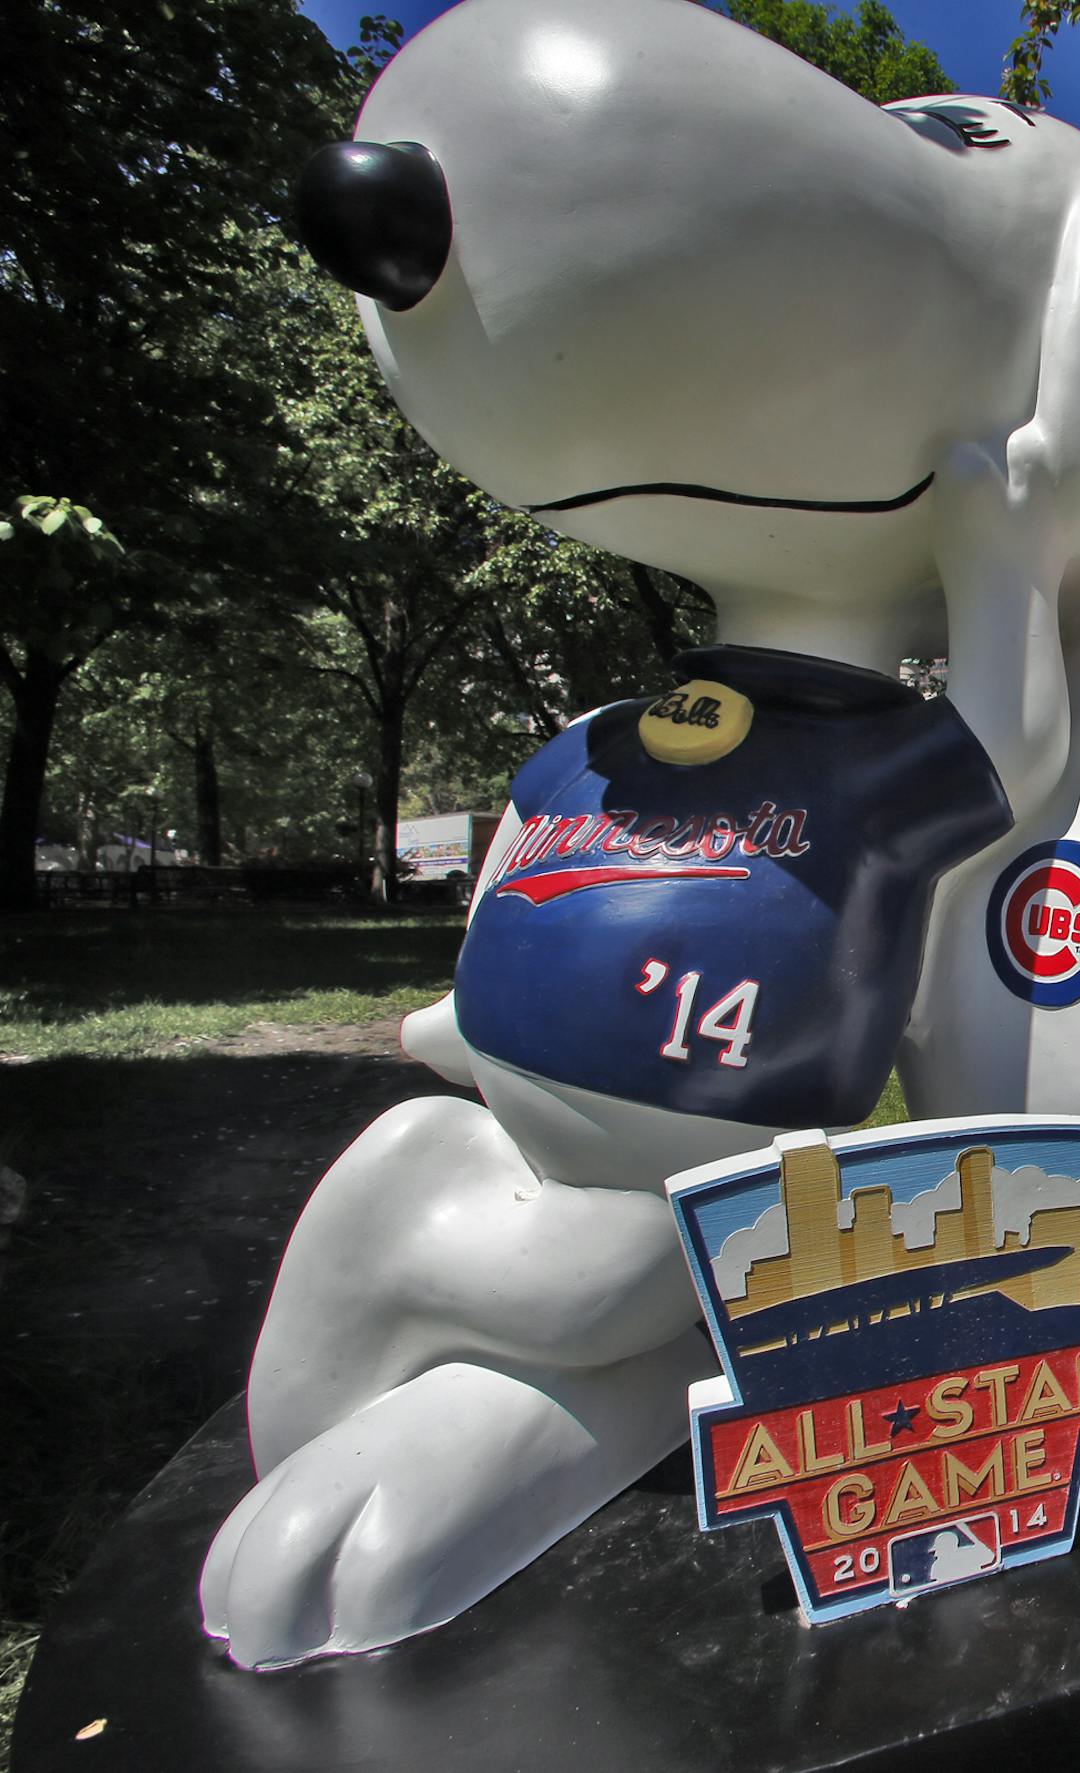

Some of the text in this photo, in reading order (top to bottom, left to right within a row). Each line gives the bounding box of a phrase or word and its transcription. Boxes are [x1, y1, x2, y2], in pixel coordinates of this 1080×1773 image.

[485, 800, 811, 893] Minnesota
[727, 1400, 893, 1491] ALL
[822, 1428, 1052, 1540] GAME
[833, 1503, 1048, 1583] 20 14
